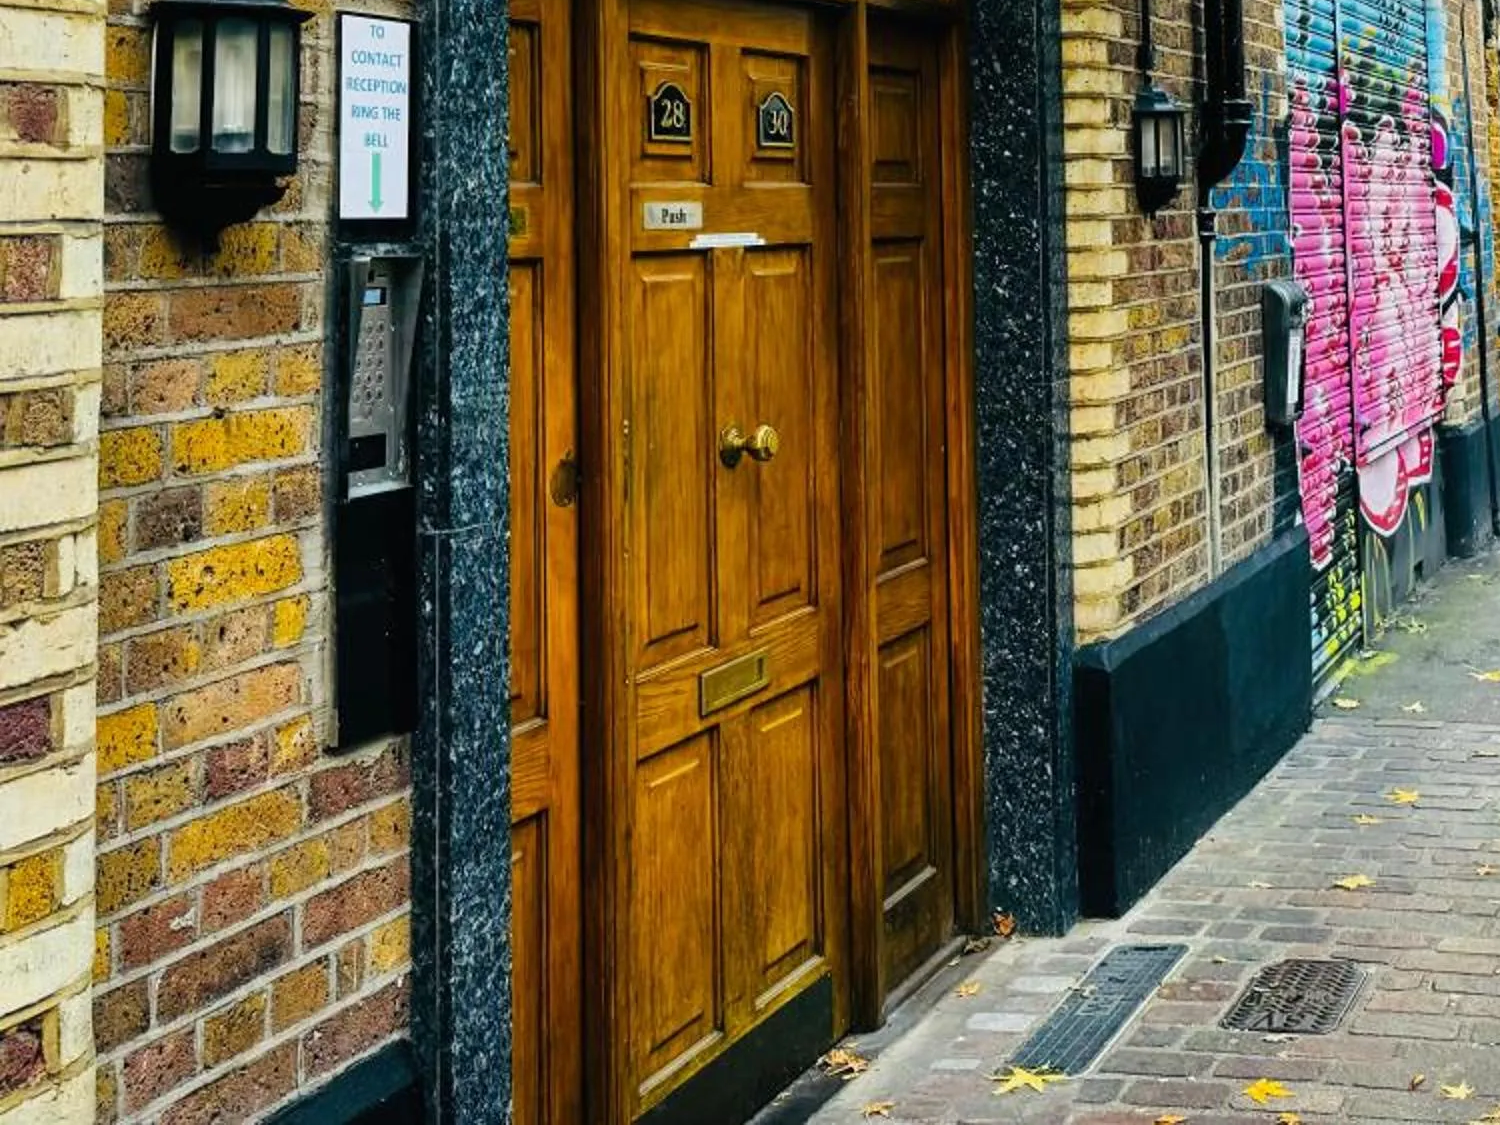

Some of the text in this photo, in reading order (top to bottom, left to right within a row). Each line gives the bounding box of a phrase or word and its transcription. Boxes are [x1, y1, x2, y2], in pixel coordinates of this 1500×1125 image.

[370, 25, 385, 39] TO
[351, 50, 403, 67] CONTACT
[346, 77, 406, 94] RECEPTION
[351, 105, 401, 122] RING THE
[661, 99, 685, 128] 28
[769, 110, 788, 135] 30
[364, 133, 388, 148] BELL
[661, 208, 687, 224] Push
